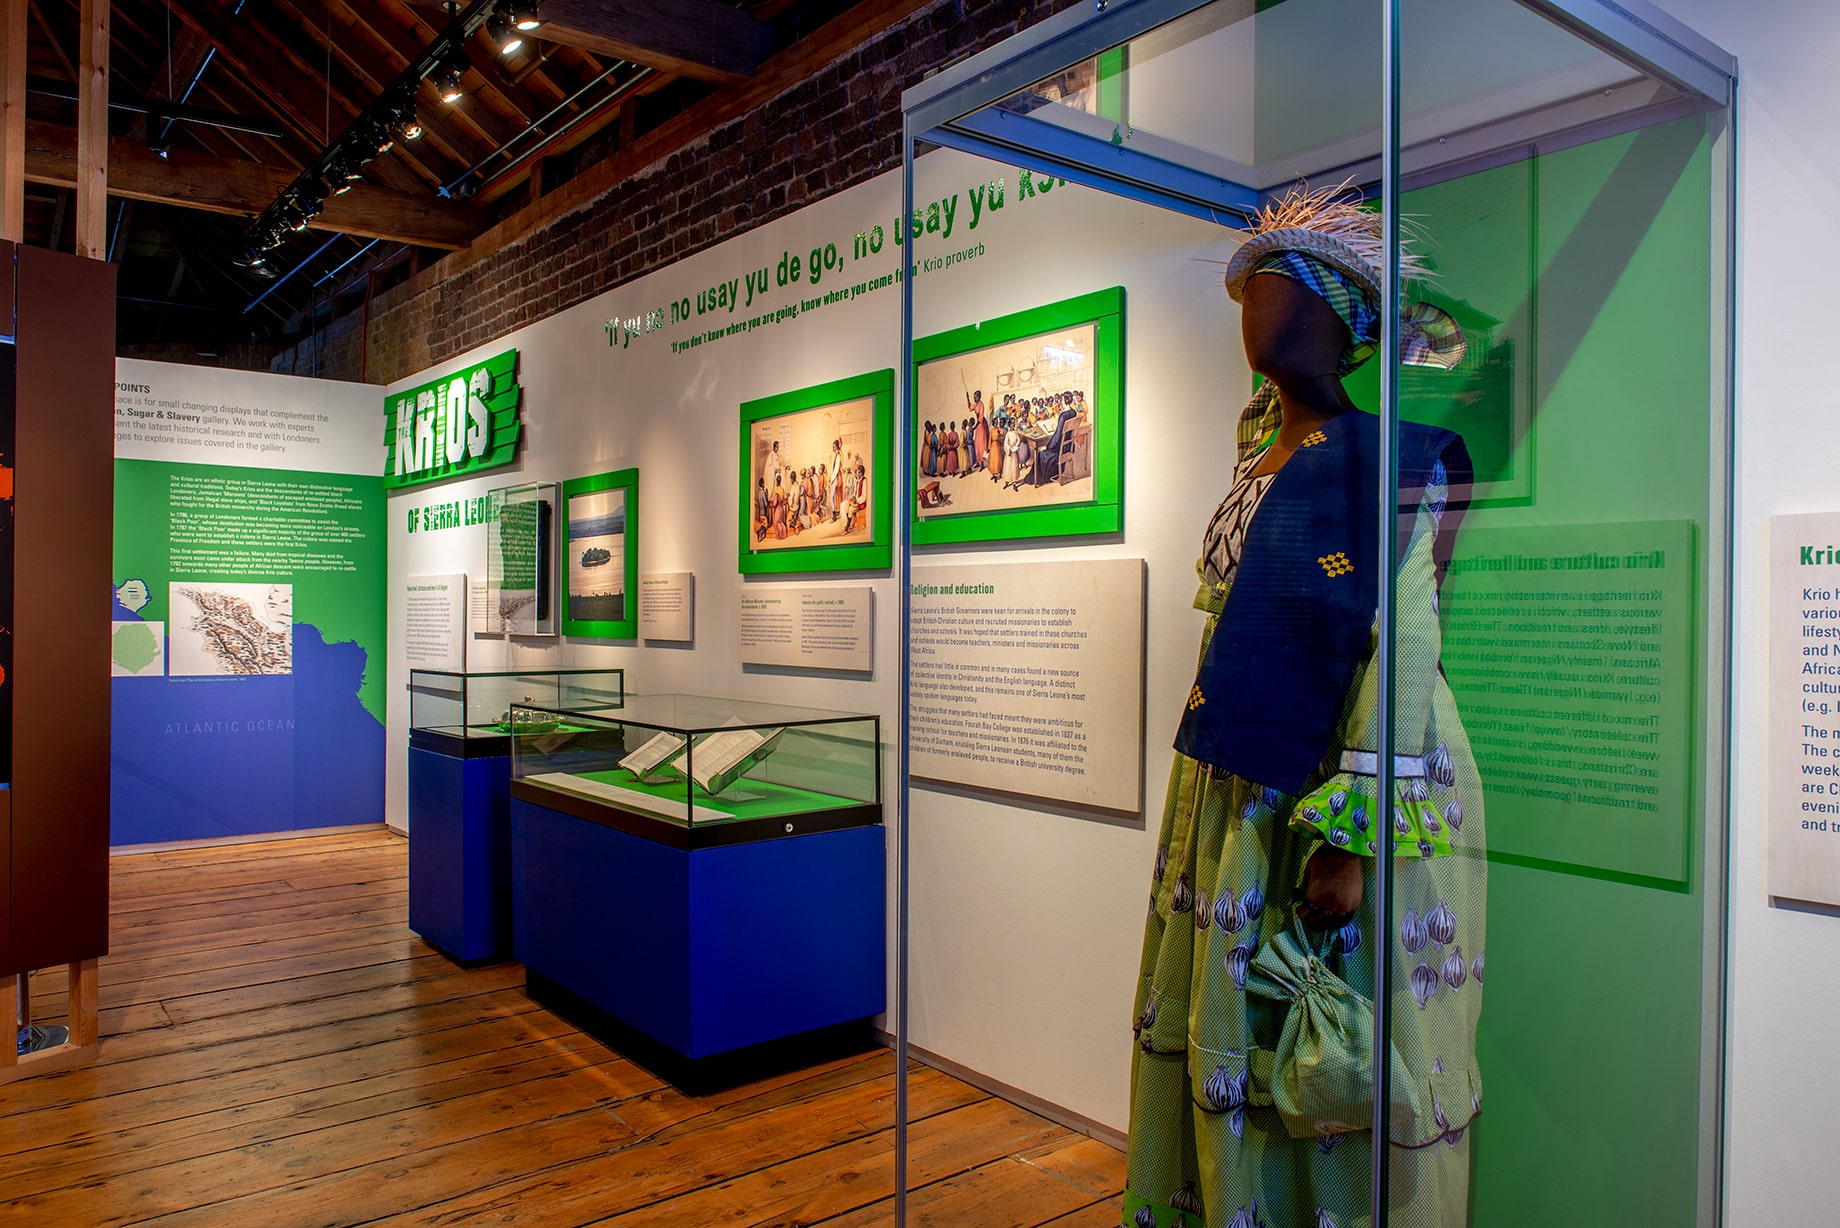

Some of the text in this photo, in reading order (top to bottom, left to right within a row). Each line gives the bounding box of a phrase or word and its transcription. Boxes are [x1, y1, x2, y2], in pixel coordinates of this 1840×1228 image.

[623, 315, 641, 349] yu
[646, 307, 664, 333] no
[670, 297, 690, 325] no
[697, 278, 739, 315] usay
[745, 267, 768, 307] yu
[776, 251, 801, 287] de
[809, 242, 844, 284] go,
[854, 225, 884, 261] no
[968, 176, 1005, 229] yu
[679, 339, 690, 354] you
[691, 332, 707, 348] don't
[707, 328, 725, 343] know
[726, 322, 746, 336] where
[748, 316, 761, 332] you
[762, 312, 775, 324] are
[801, 296, 822, 313] know
[823, 288, 849, 306] where
[850, 282, 867, 301] you
[868, 274, 893, 291] come
[924, 256, 943, 273] Krio
[946, 241, 985, 269] proverb
[134, 397, 141, 406] is
[144, 398, 155, 407] for
[158, 399, 179, 409] small
[181, 401, 218, 414] changing
[219, 404, 250, 417] displays
[253, 407, 268, 417] that
[270, 409, 314, 422] complement
[316, 413, 329, 422] the
[127, 407, 153, 419] Sugar
[166, 411, 200, 423] Slavery
[202, 414, 231, 426] gallery.
[233, 417, 246, 426] We
[248, 418, 266, 428] work
[269, 420, 285, 429] with
[287, 422, 315, 433] experts
[394, 367, 490, 476] KRIOS
[116, 419, 320, 444] ent the latest historical research and with Londoners
[116, 433, 287, 454] ges to explore issues covered in the gallery.
[407, 507, 420, 533] OF
[910, 583, 995, 597] Religion and education
[1802, 588, 1831, 601] Krio
[1802, 606, 1840, 619] vario
[1802, 644, 1828, 656] and
[994, 686, 1014, 695] remains
[1026, 688, 1031, 696] of
[1032, 689, 1048, 698] Sierra
[1049, 690, 1070, 699] Leone's
[1071, 692, 1086, 700] most
[1802, 681, 1840, 694] cultu
[1802, 698, 1832, 715] (e.g.
[164, 719, 296, 735] ATLANTIC OCEAN
[1801, 725, 1828, 739] The
[1801, 743, 1828, 757] The
[1801, 764, 1840, 777] week
[1801, 783, 1825, 794] are
[1801, 819, 1827, 831] and
